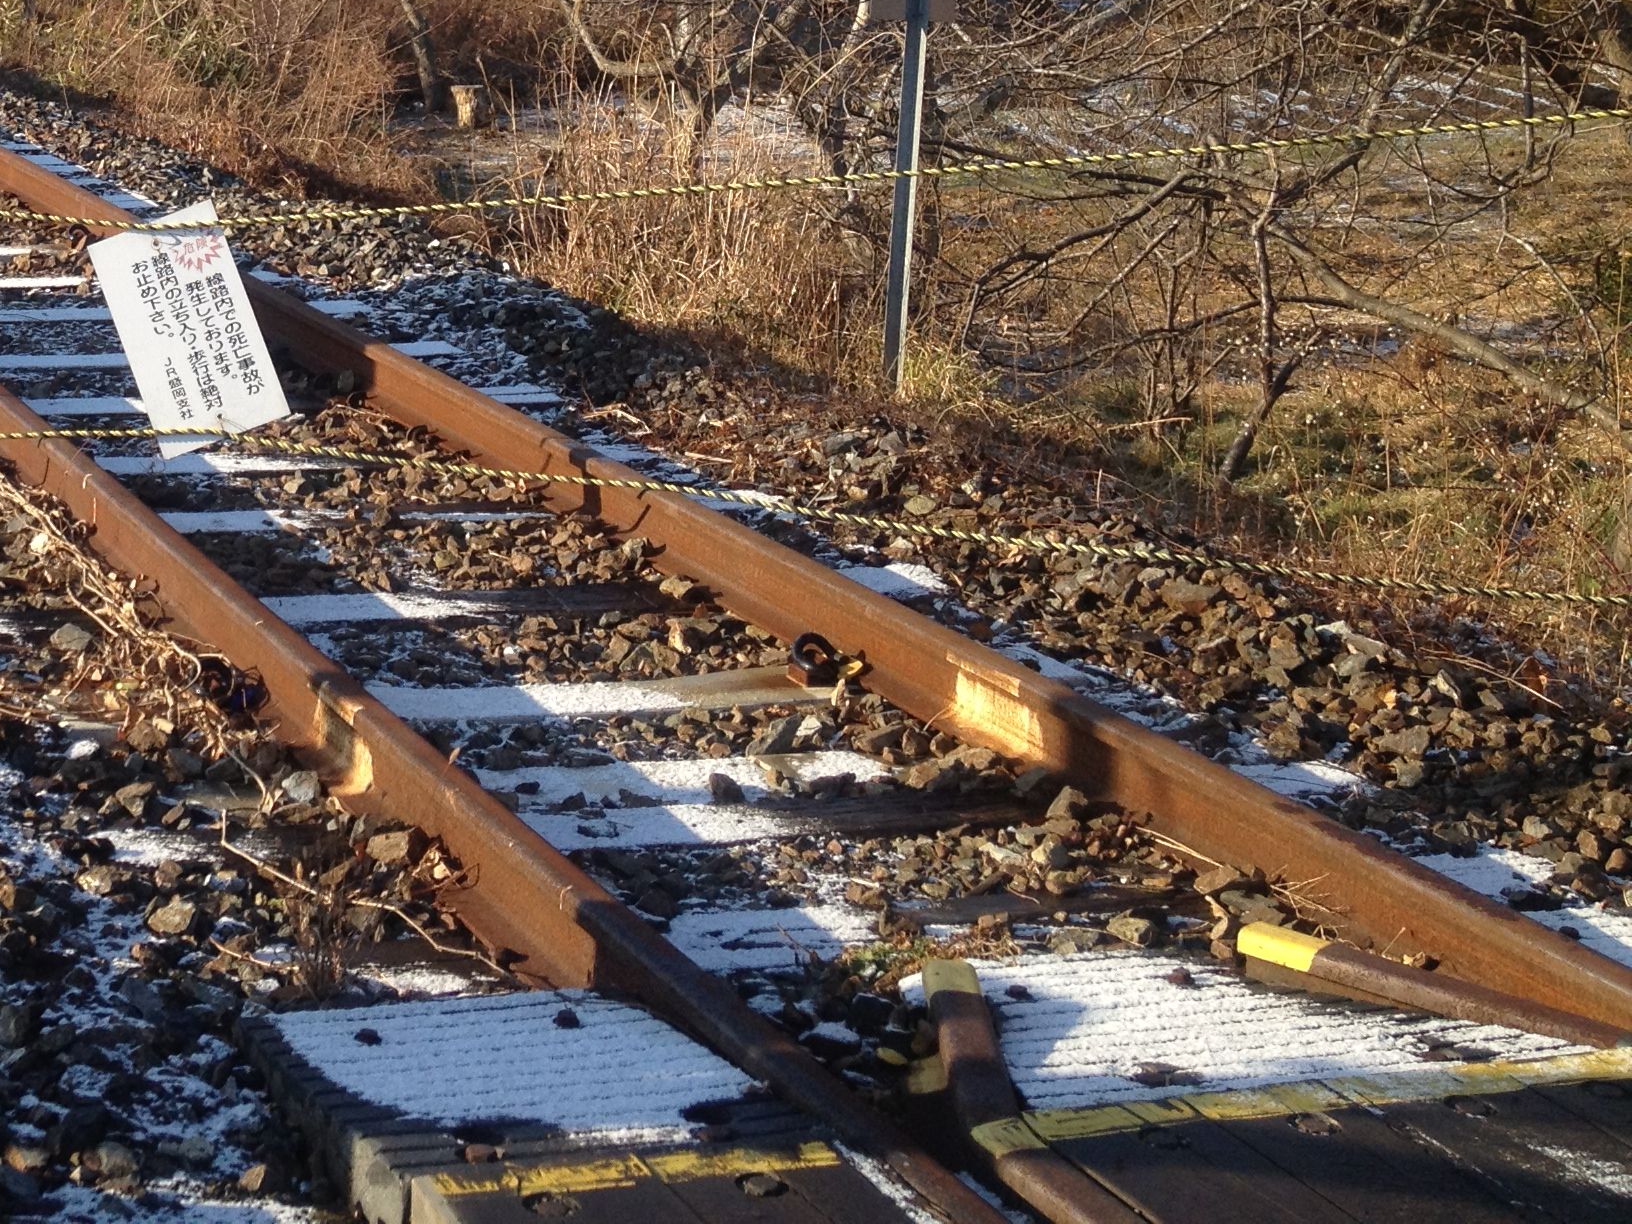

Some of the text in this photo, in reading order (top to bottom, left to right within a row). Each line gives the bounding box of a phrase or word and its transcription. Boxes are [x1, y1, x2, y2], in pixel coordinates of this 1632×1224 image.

[131, 261, 174, 338] お止め下さい。
[151, 252, 223, 411] 線路内の立ち入り・歩行は絶対
[186, 280, 237, 379] 発生しております。
[205, 272, 264, 396] 線路内での死亡事故が
